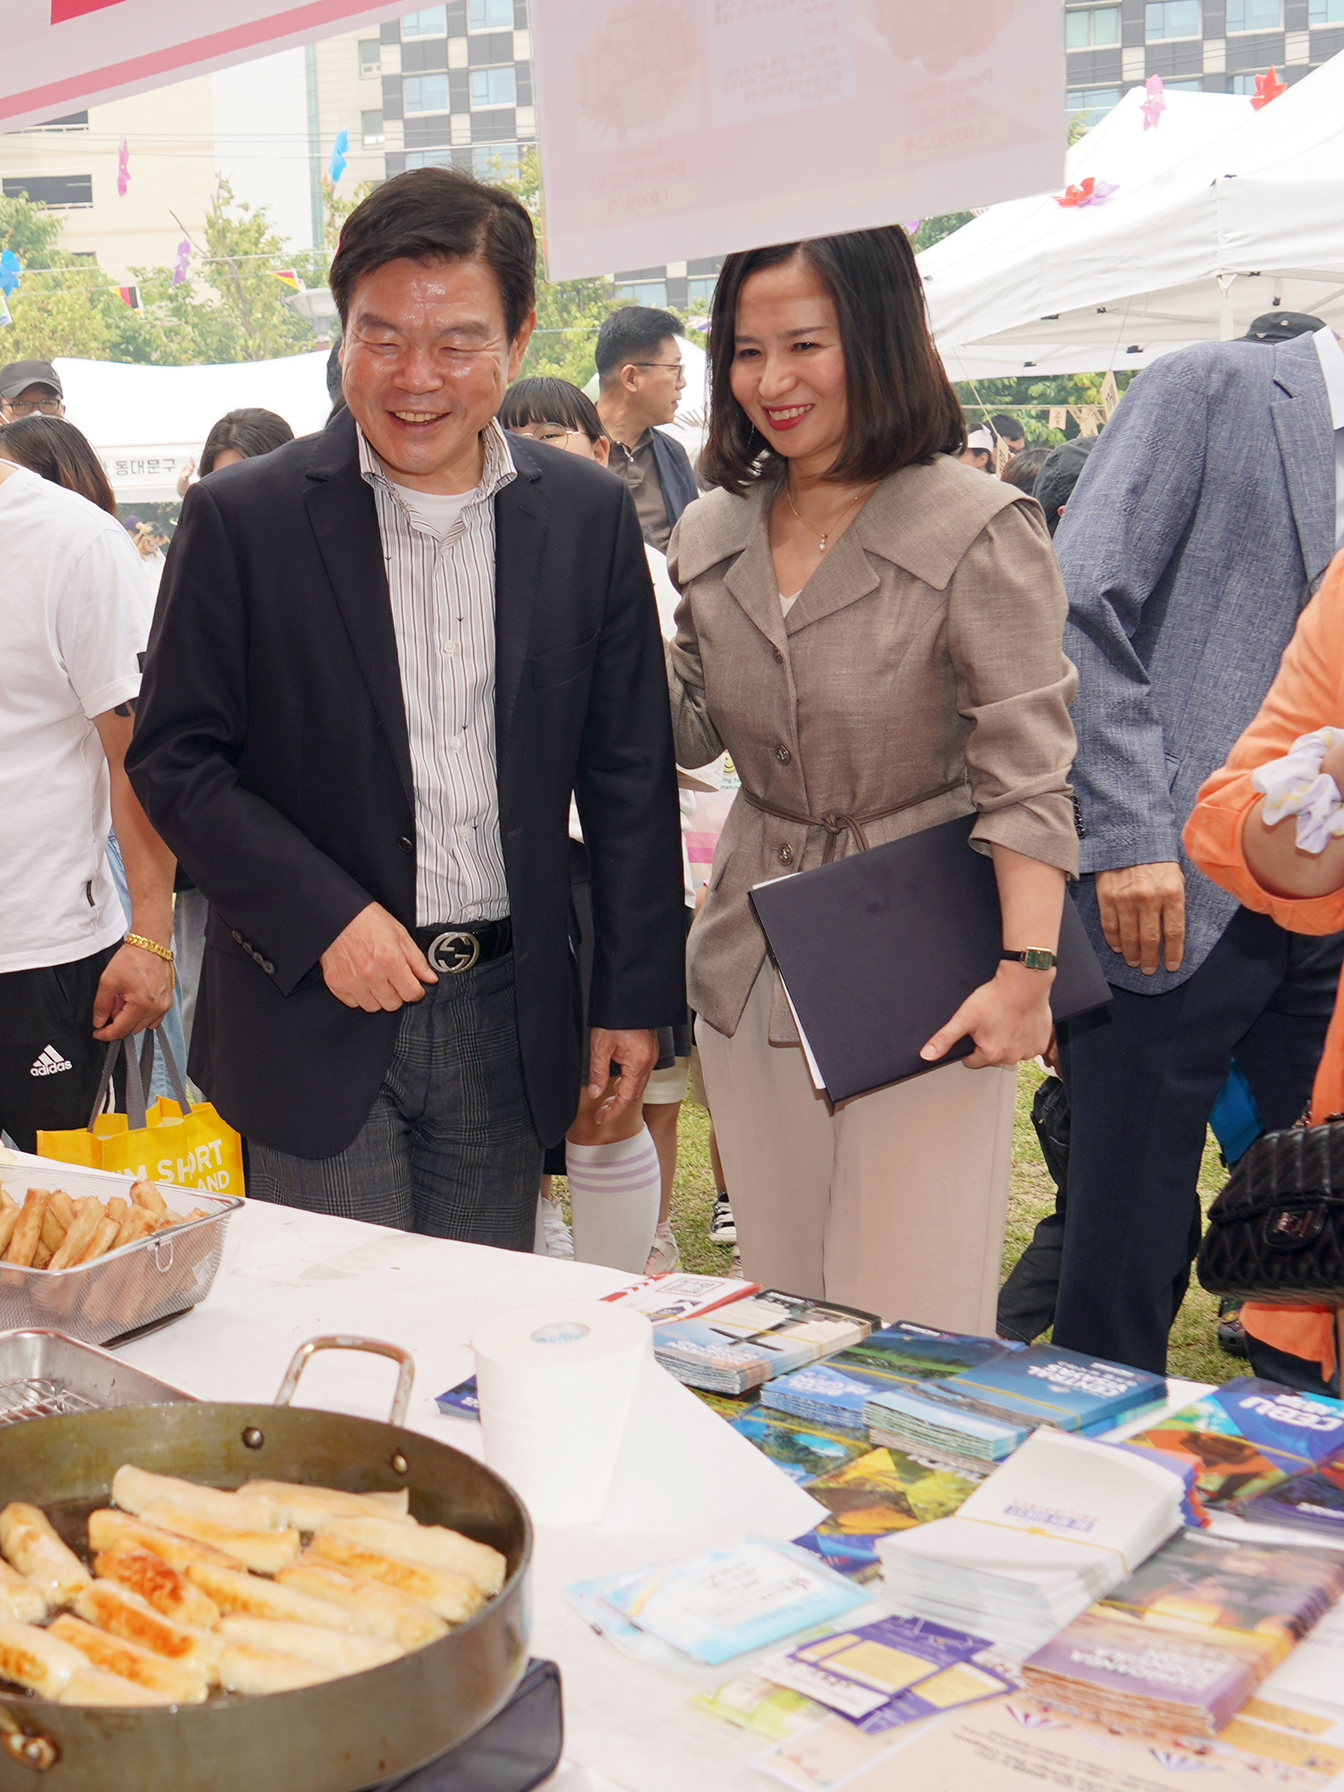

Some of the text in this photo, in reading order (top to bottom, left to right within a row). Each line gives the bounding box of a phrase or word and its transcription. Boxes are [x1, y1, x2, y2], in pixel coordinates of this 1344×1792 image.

[115, 458, 176, 476] 동대문구
[30, 1060, 73, 1077] adidas
[1237, 1396, 1344, 1432] CEBU
